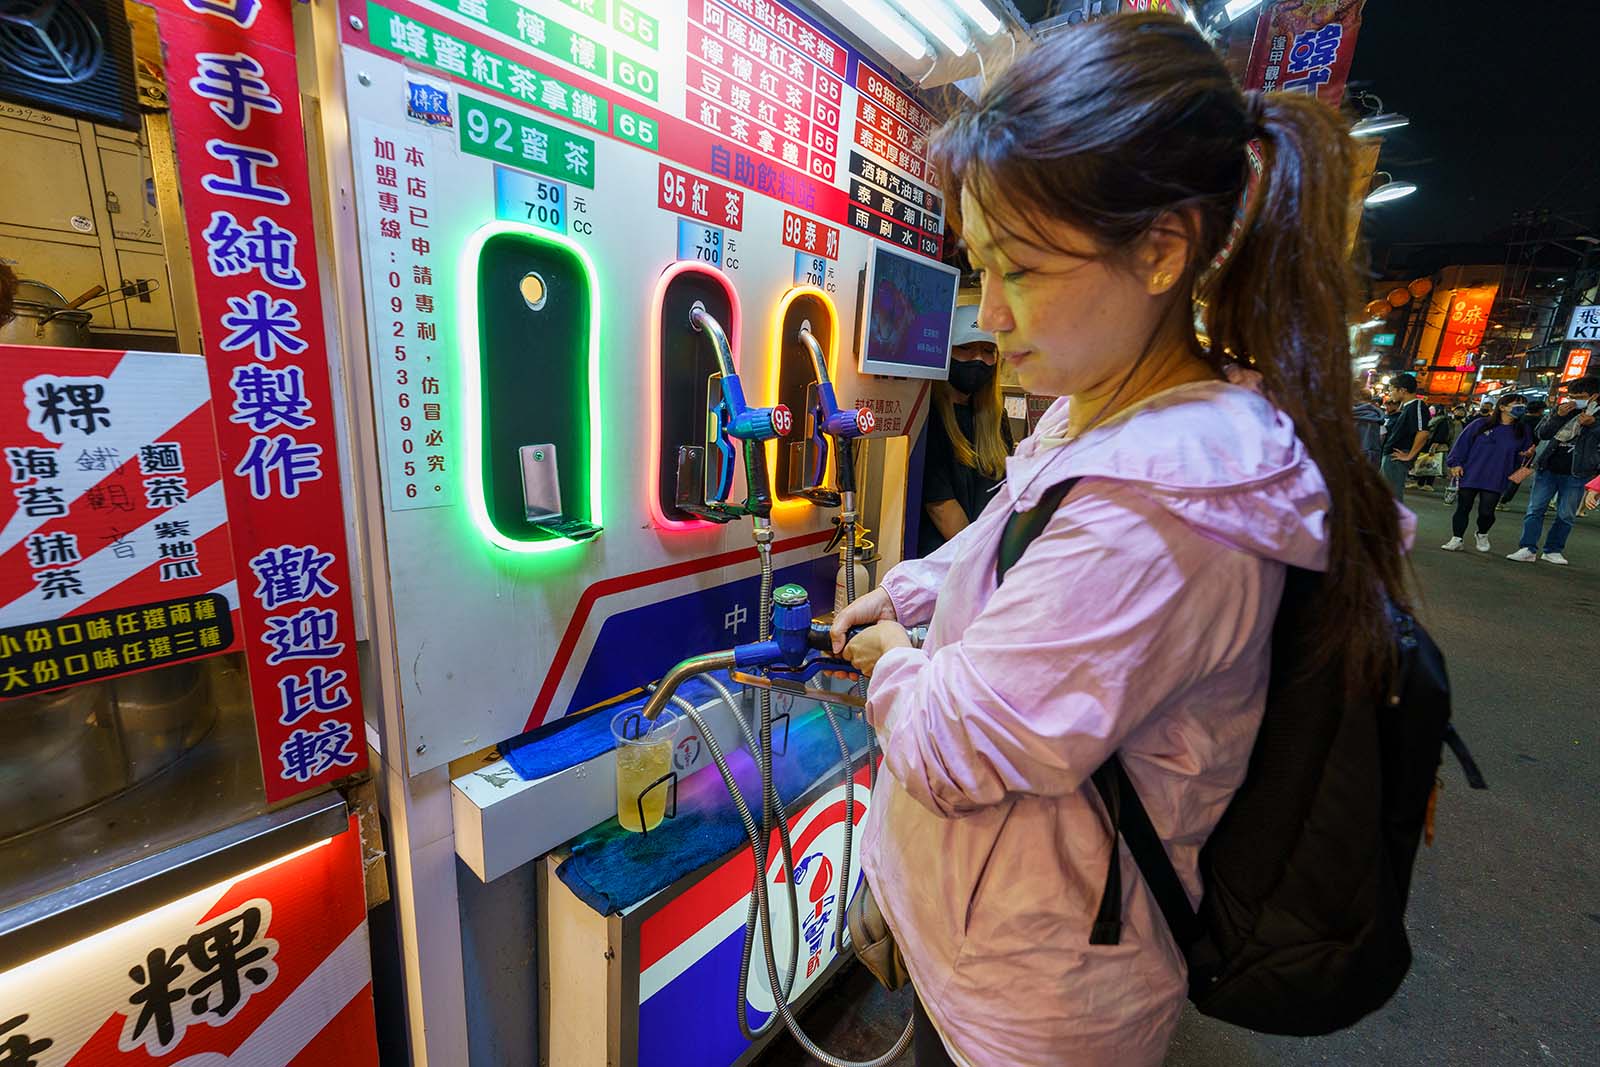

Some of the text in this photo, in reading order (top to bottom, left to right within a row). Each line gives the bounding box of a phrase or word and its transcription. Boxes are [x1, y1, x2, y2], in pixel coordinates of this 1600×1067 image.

[618, 62, 654, 93] 60
[703, 2, 839, 99] 阿薩姆紅茶 35
[388, 15, 654, 144] 蜂蜜紅茶拿鐵 65
[701, 36, 838, 127] 檸檬紅茶 50
[701, 70, 834, 154] 豆漿紅茶 55
[862, 102, 922, 153] 泰式奶茶
[700, 101, 833, 180] 紅茶拿鐵 60
[537, 183, 587, 214] 50 元
[711, 146, 816, 210] 自助飲料站
[857, 185, 916, 225] 泰高潮
[861, 159, 924, 206] 酒精汽油類
[525, 202, 592, 235] 700 CC
[704, 229, 736, 252] 35 元
[855, 209, 937, 254] 雨刷水 130
[696, 245, 739, 270] 700 CC
[806, 271, 823, 287] 700
[812, 259, 835, 279] 65 元
[36, 382, 111, 436] 粿
[775, 409, 791, 431] 95
[859, 411, 875, 431] 98
[10, 448, 67, 518] 海苔
[139, 443, 187, 508] 麵茶
[28, 533, 85, 600] 抹茶
[154, 520, 201, 581] 紫地瓜
[0, 598, 217, 659] 小份口味任選兩種
[724, 603, 747, 635] 中
[0, 625, 222, 691] 大份口味任選三種
[249, 544, 356, 782] 歡迎比較
[128, 906, 270, 1047] 粿
